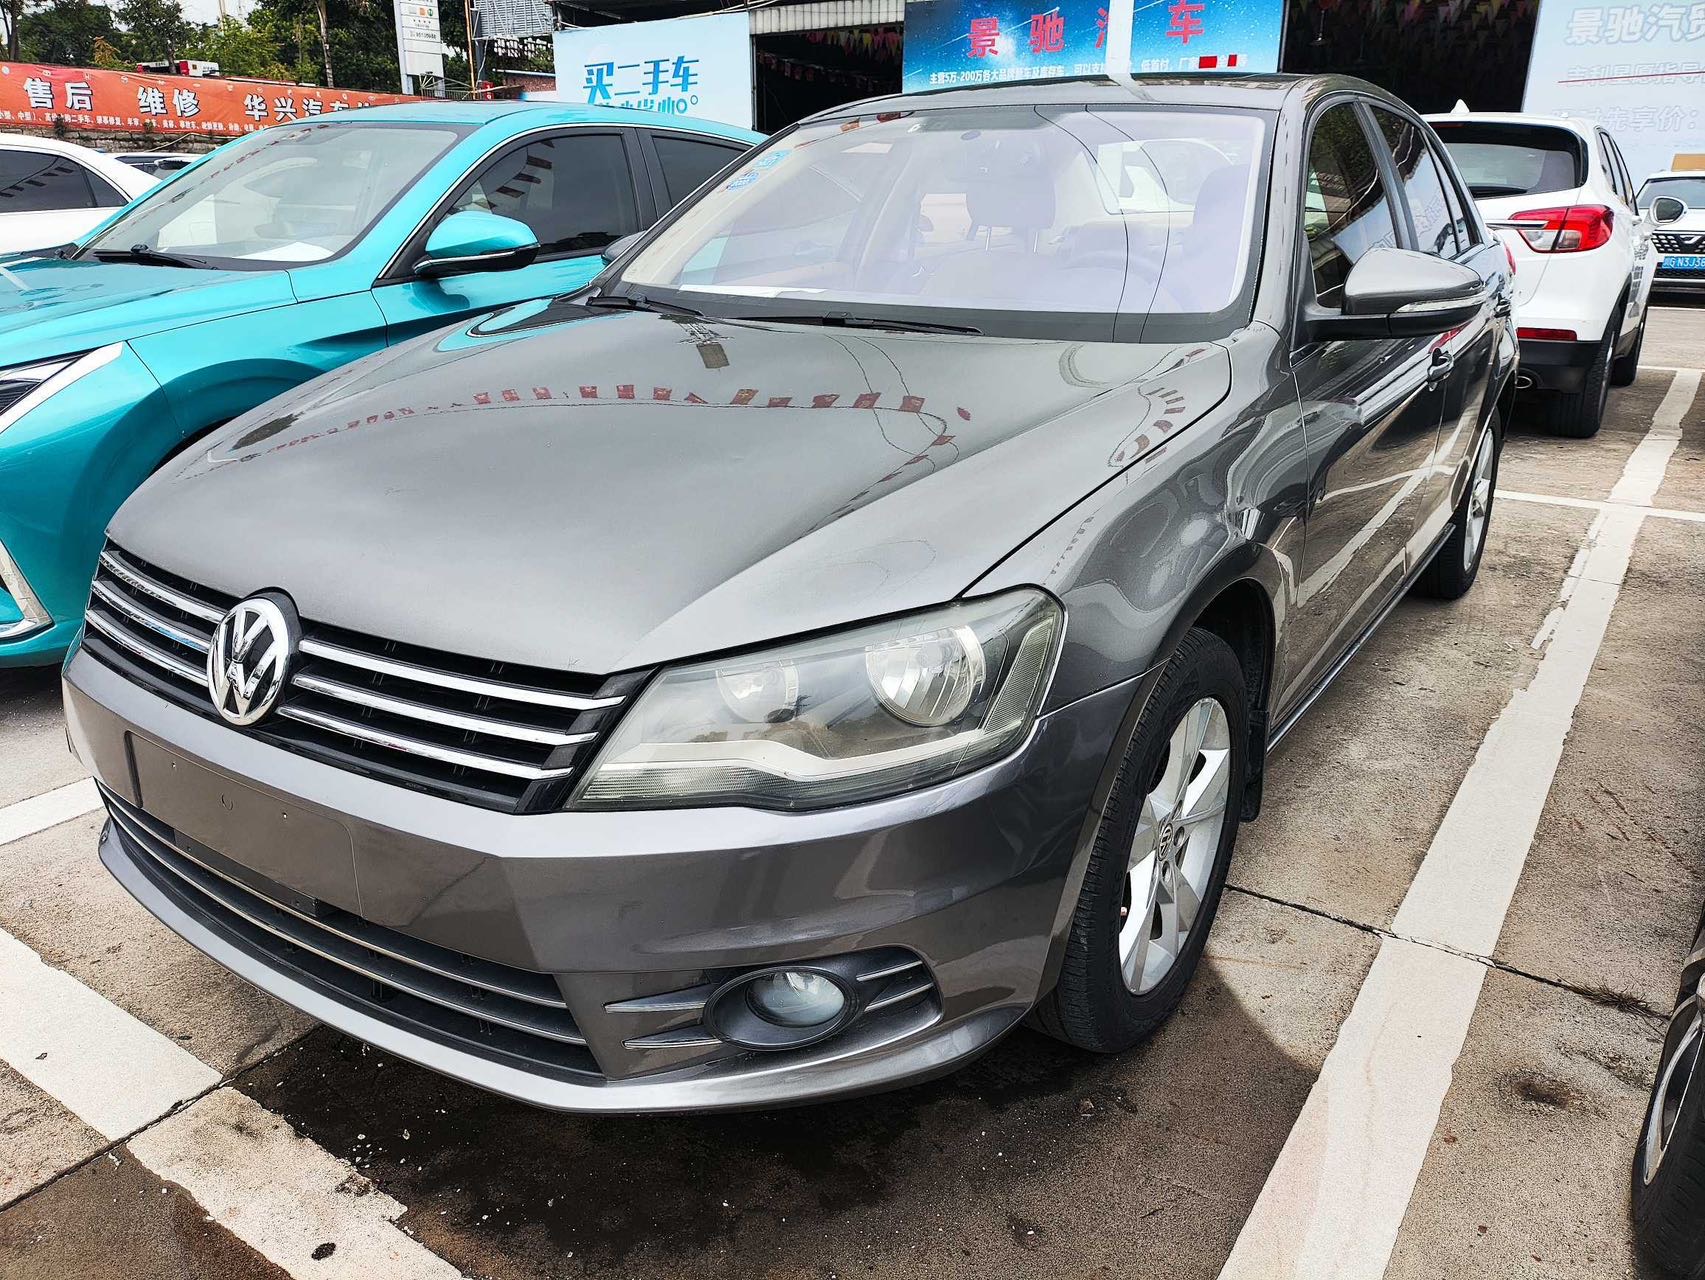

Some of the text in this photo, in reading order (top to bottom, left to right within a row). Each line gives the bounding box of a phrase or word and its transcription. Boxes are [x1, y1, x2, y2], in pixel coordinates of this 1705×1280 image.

[583, 55, 699, 104] 买二手车
[1567, 61, 1705, 88] 吉利星愿指导
[23, 77, 94, 111] 售后
[137, 85, 201, 118] 维修
